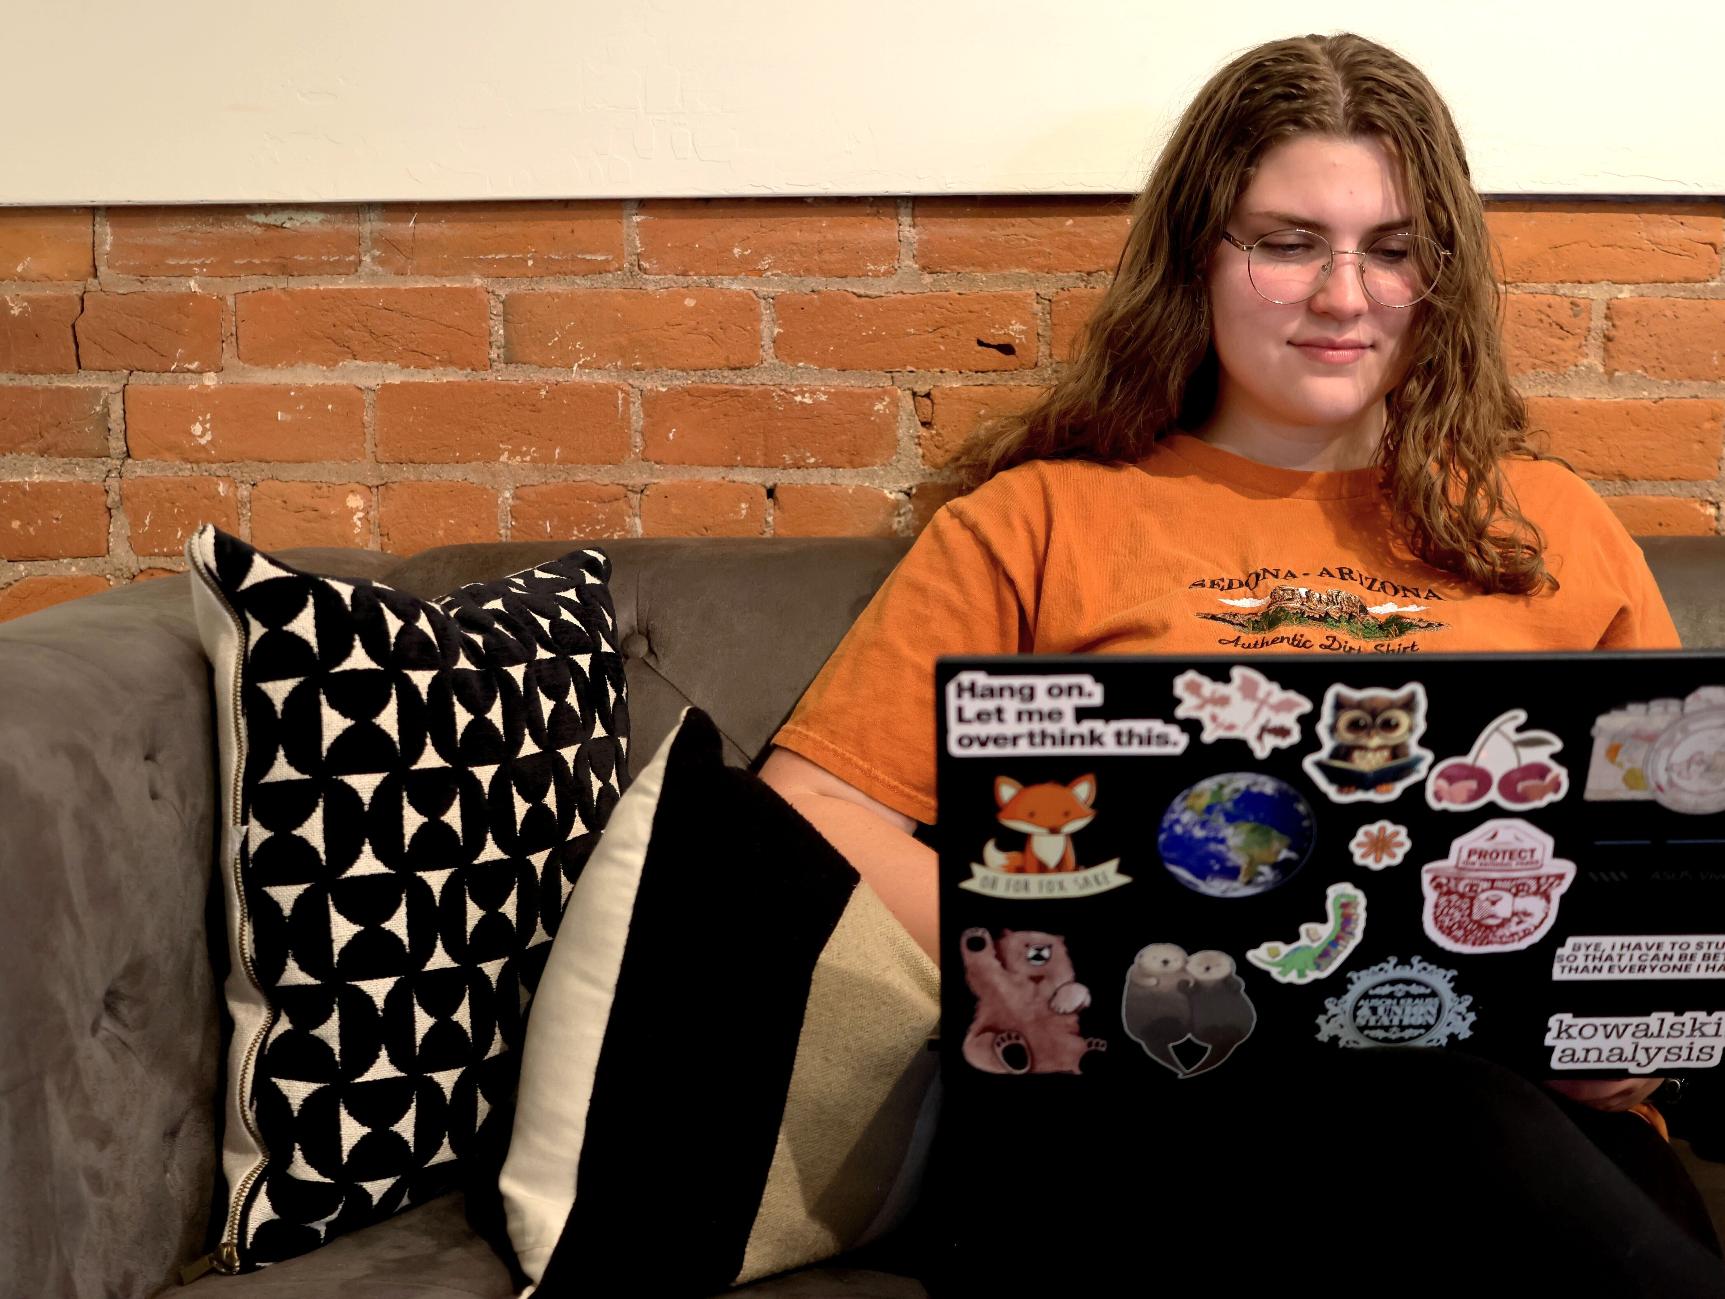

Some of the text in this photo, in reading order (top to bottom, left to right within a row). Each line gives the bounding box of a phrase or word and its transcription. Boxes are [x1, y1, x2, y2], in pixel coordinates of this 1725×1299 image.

[1318, 566, 1446, 601] ARIZONA
[1218, 633, 1314, 649] Authentic
[957, 681, 1094, 702] Hang on.
[958, 706, 1063, 724] Let me
[958, 727, 1178, 749] overthink this.
[1467, 847, 1538, 861] PROTECT
[1572, 941, 1606, 954] BYE,
[1620, 941, 1665, 952] HAVE
[1668, 941, 1691, 951] TO
[1556, 954, 1577, 964] SO
[1583, 953, 1626, 964] THAT
[1638, 953, 1674, 963] CAN
[1678, 952, 1698, 962] BE
[1560, 964, 1602, 975] THAN
[1607, 963, 1692, 974] EVERYONE
[1552, 1016, 1723, 1041] kowalski
[1558, 1041, 1716, 1067] analysis
